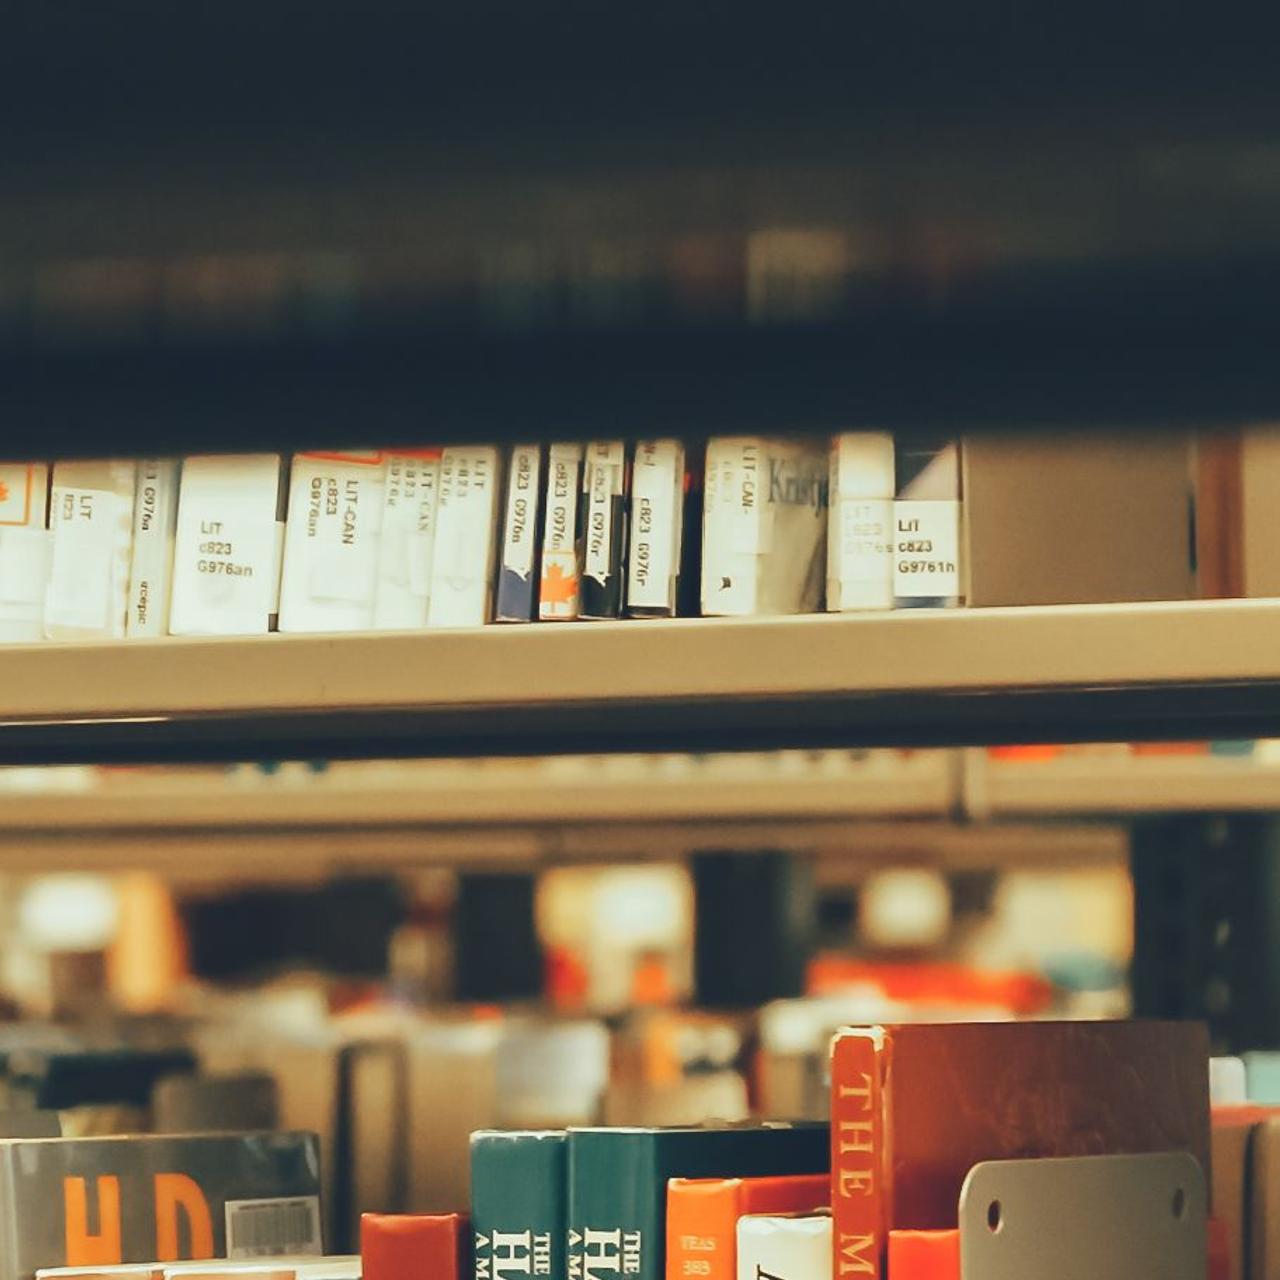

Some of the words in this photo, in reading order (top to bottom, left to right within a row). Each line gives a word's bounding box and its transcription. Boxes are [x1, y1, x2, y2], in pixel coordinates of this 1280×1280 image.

[474, 459, 487, 490] LIT
[80, 496, 93, 520] LIT
[326, 478, 338, 516] c823
[343, 480, 359, 545] LIT-CAN
[639, 497, 651, 534] c823
[898, 519, 921, 532] LIT
[201, 521, 224, 534] LIT
[199, 541, 232, 555] c823
[898, 540, 933, 553] c823
[839, 1072, 874, 1200] THE
[475, 1231, 491, 1249] A
[568, 1231, 583, 1247] A
[623, 1231, 642, 1274] THE
[534, 1232, 551, 1275] THE
